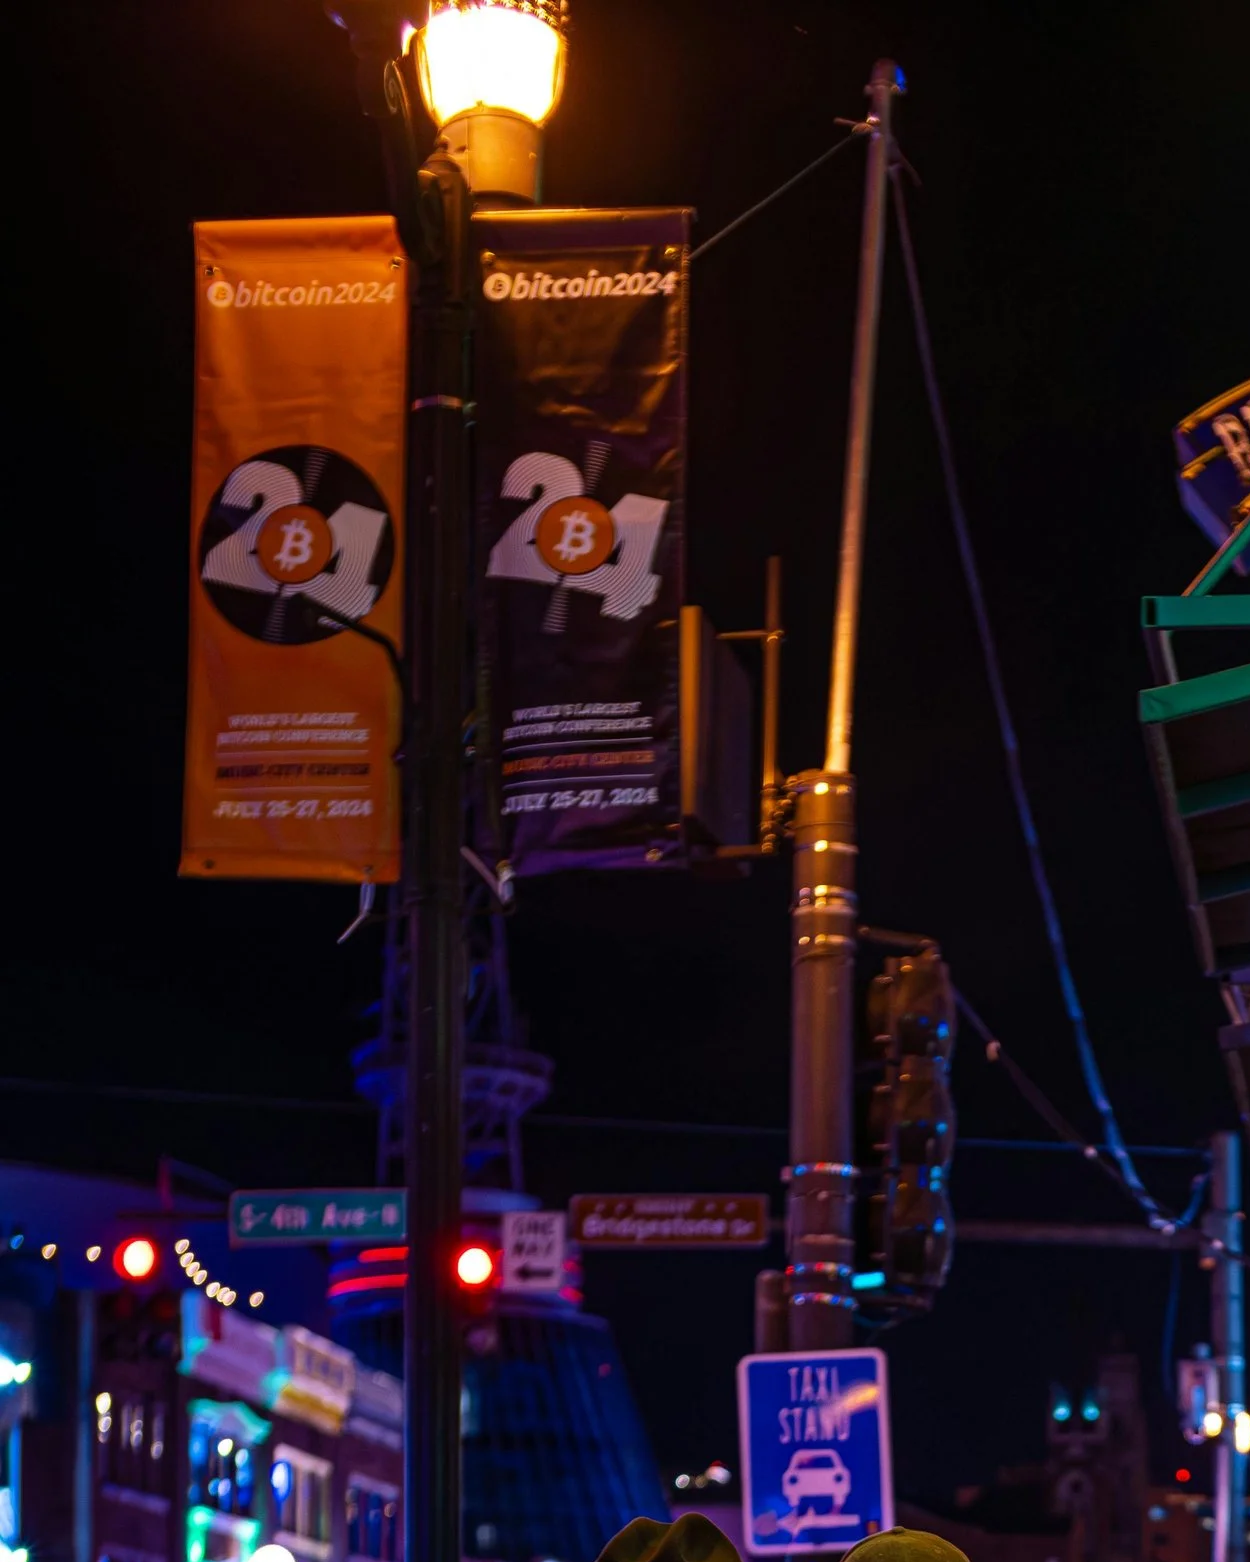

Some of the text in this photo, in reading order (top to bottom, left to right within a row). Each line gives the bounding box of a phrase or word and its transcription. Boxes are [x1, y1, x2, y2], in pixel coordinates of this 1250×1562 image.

[233, 280, 396, 308] bitcoin2024
[511, 270, 676, 301] bitcoin2024
[787, 1366, 841, 1402] TAXI
[778, 1406, 851, 1444] STAND
